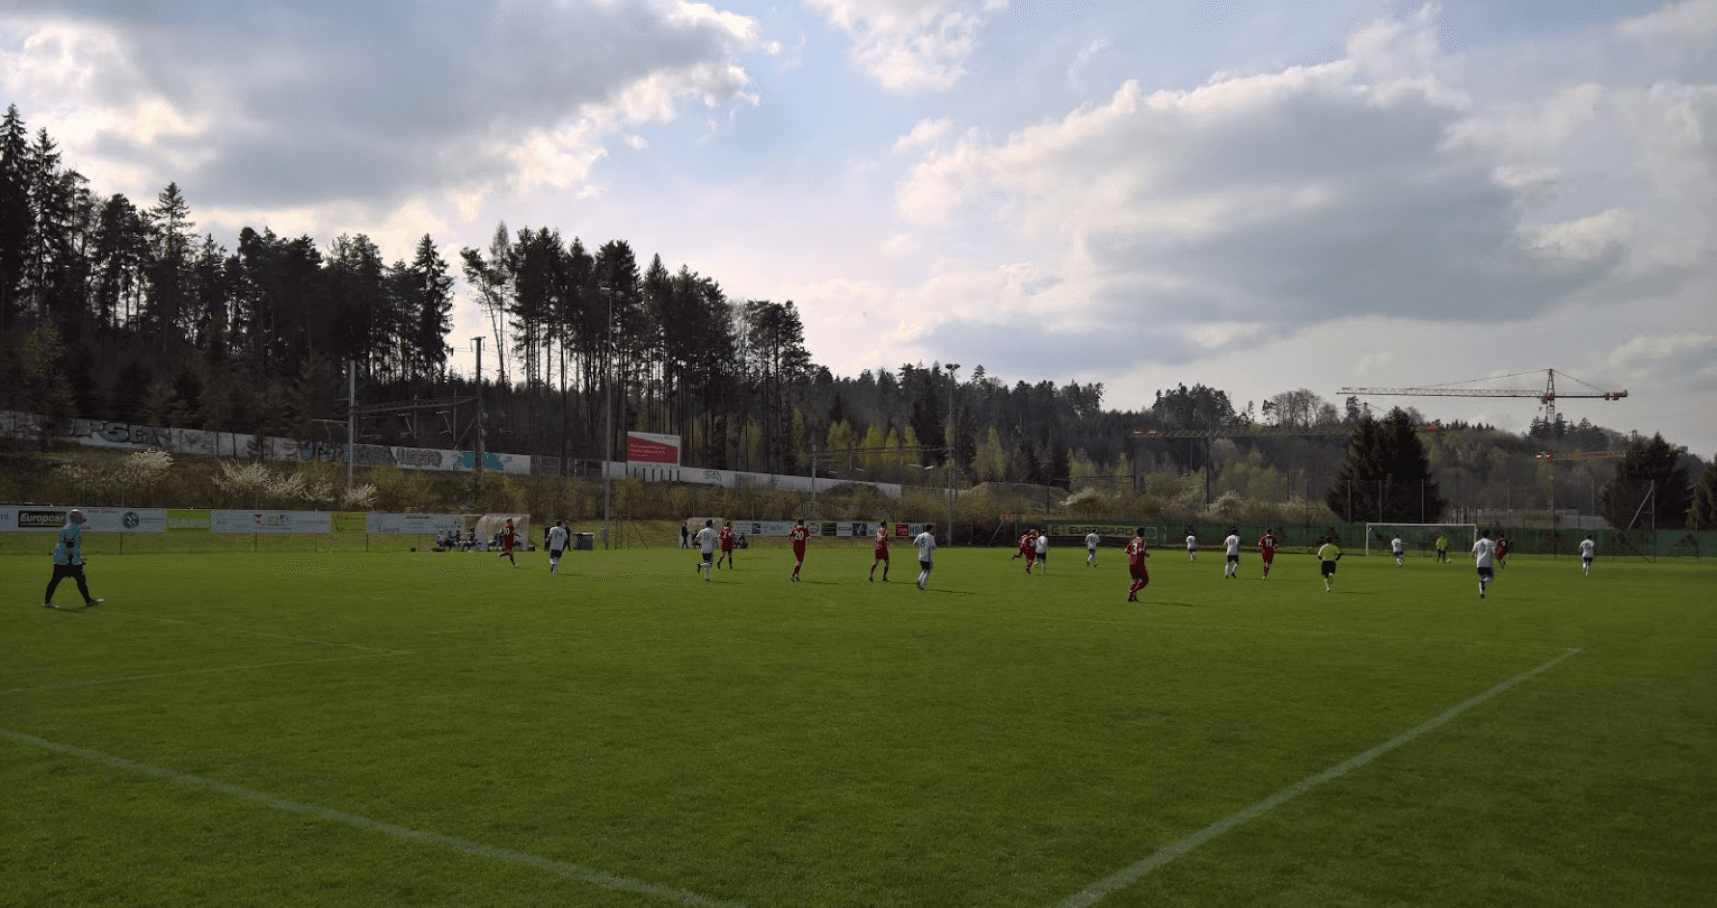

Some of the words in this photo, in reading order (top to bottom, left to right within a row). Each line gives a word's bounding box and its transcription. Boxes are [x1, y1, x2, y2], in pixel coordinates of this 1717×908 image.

[19, 512, 65, 524] Europcar
[794, 531, 804, 541] 20
[1132, 543, 1138, 555] 3
